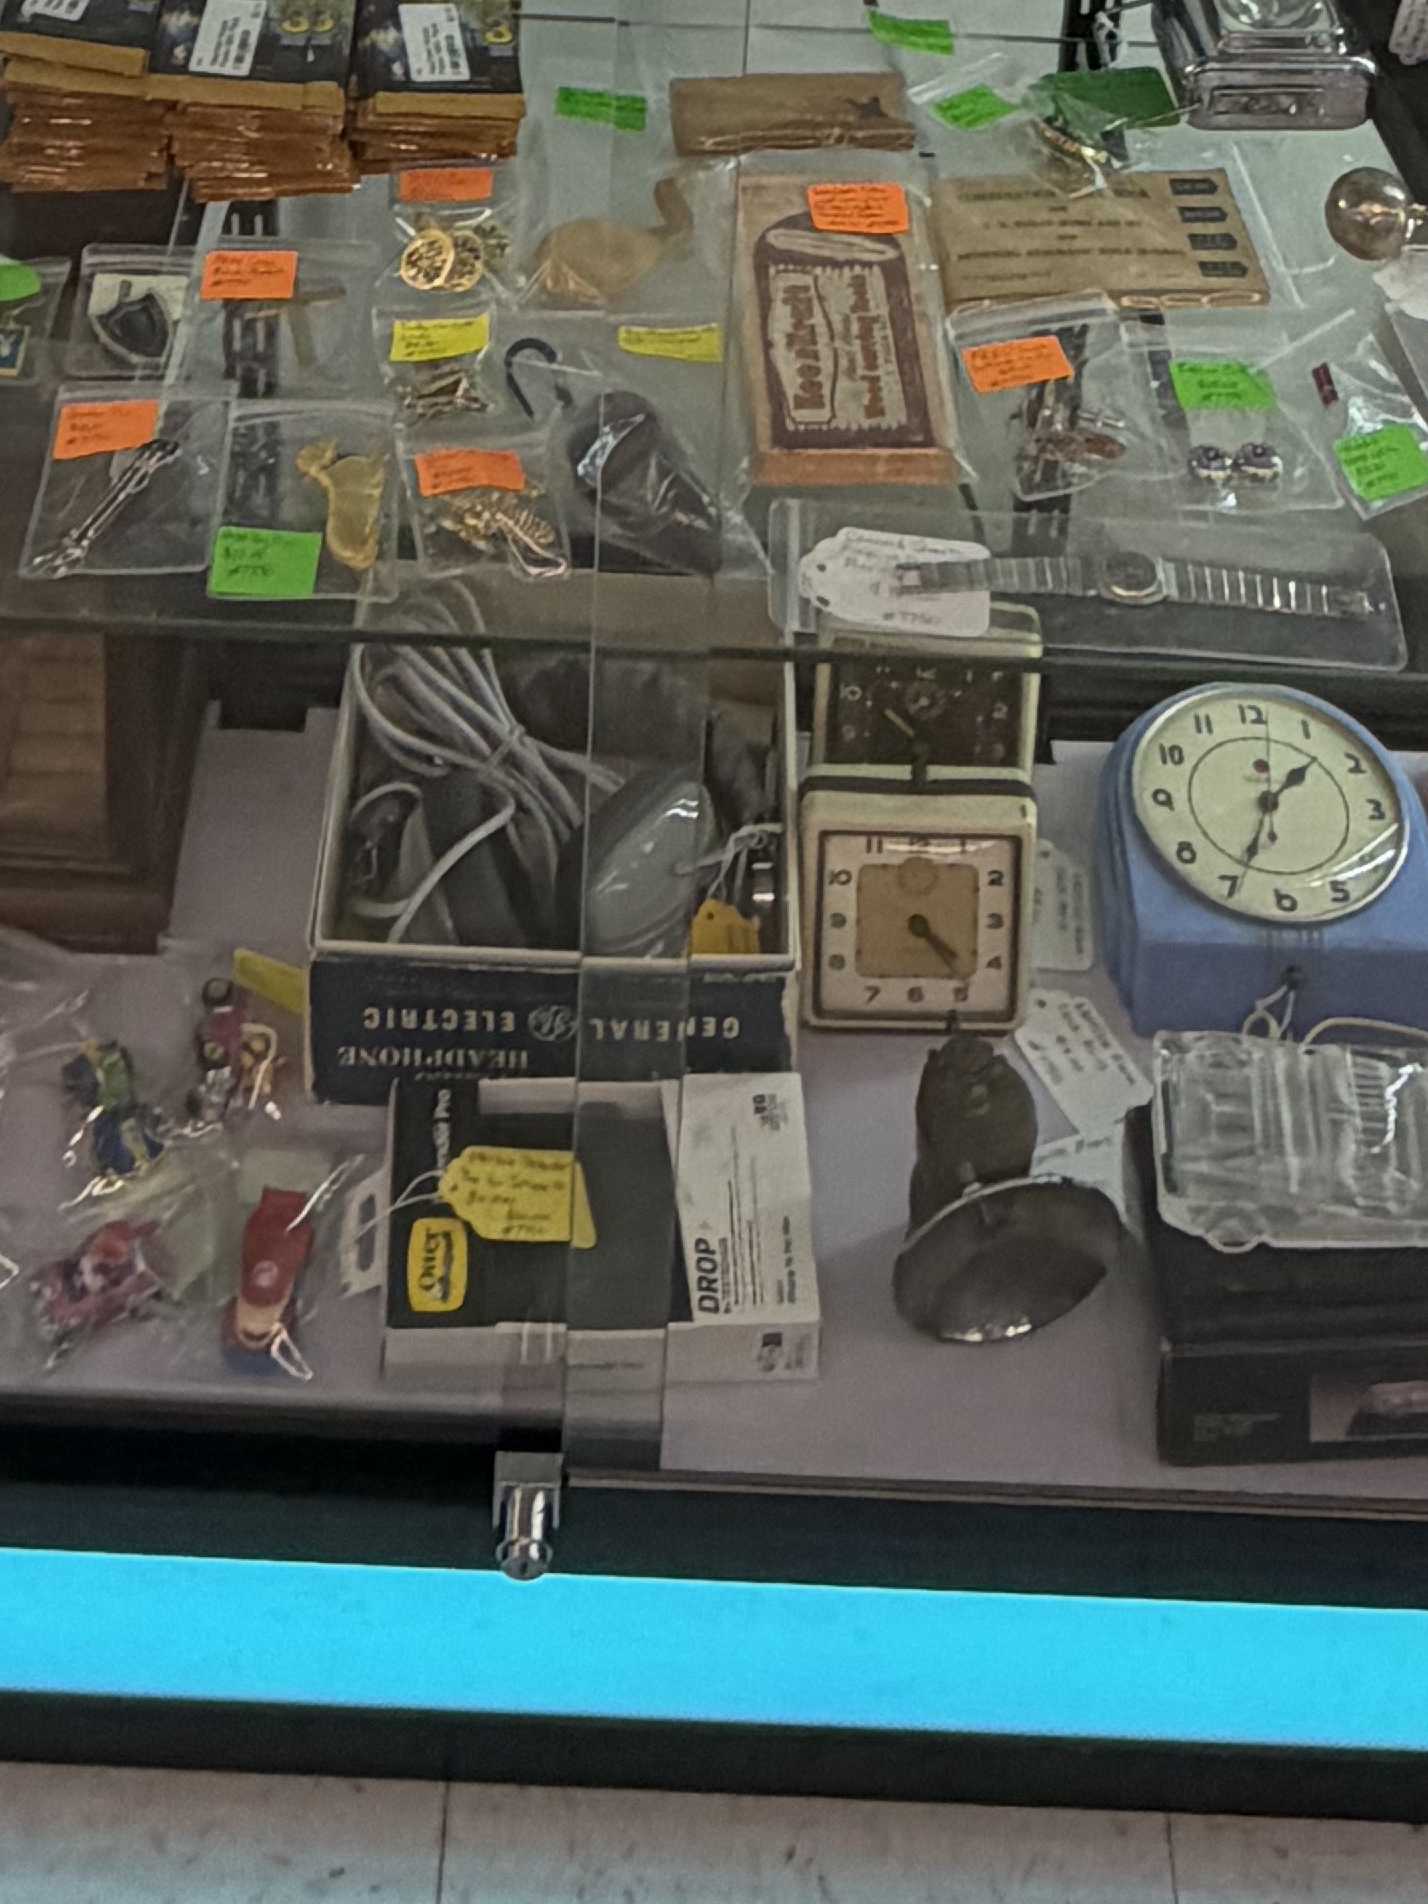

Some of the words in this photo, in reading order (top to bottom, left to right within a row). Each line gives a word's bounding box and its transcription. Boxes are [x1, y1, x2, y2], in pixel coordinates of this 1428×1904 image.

[1194, 713, 1214, 736] 11
[1238, 703, 1269, 726] 12
[1300, 718, 1312, 740] 1
[1159, 743, 1185, 766] 10
[1343, 751, 1368, 774] 2
[1152, 788, 1176, 811] 9
[1366, 798, 1386, 821] 3
[1176, 840, 1197, 865] 8
[1218, 874, 1240, 899] 7
[1329, 880, 1351, 903] 5
[1274, 888, 1299, 913] 6
[865, 986, 882, 1005] 7
[362, 1006, 517, 1033] ELECTRIC
[588, 1015, 741, 1042] GENERAL
[338, 1045, 530, 1071] HEADPHONE
